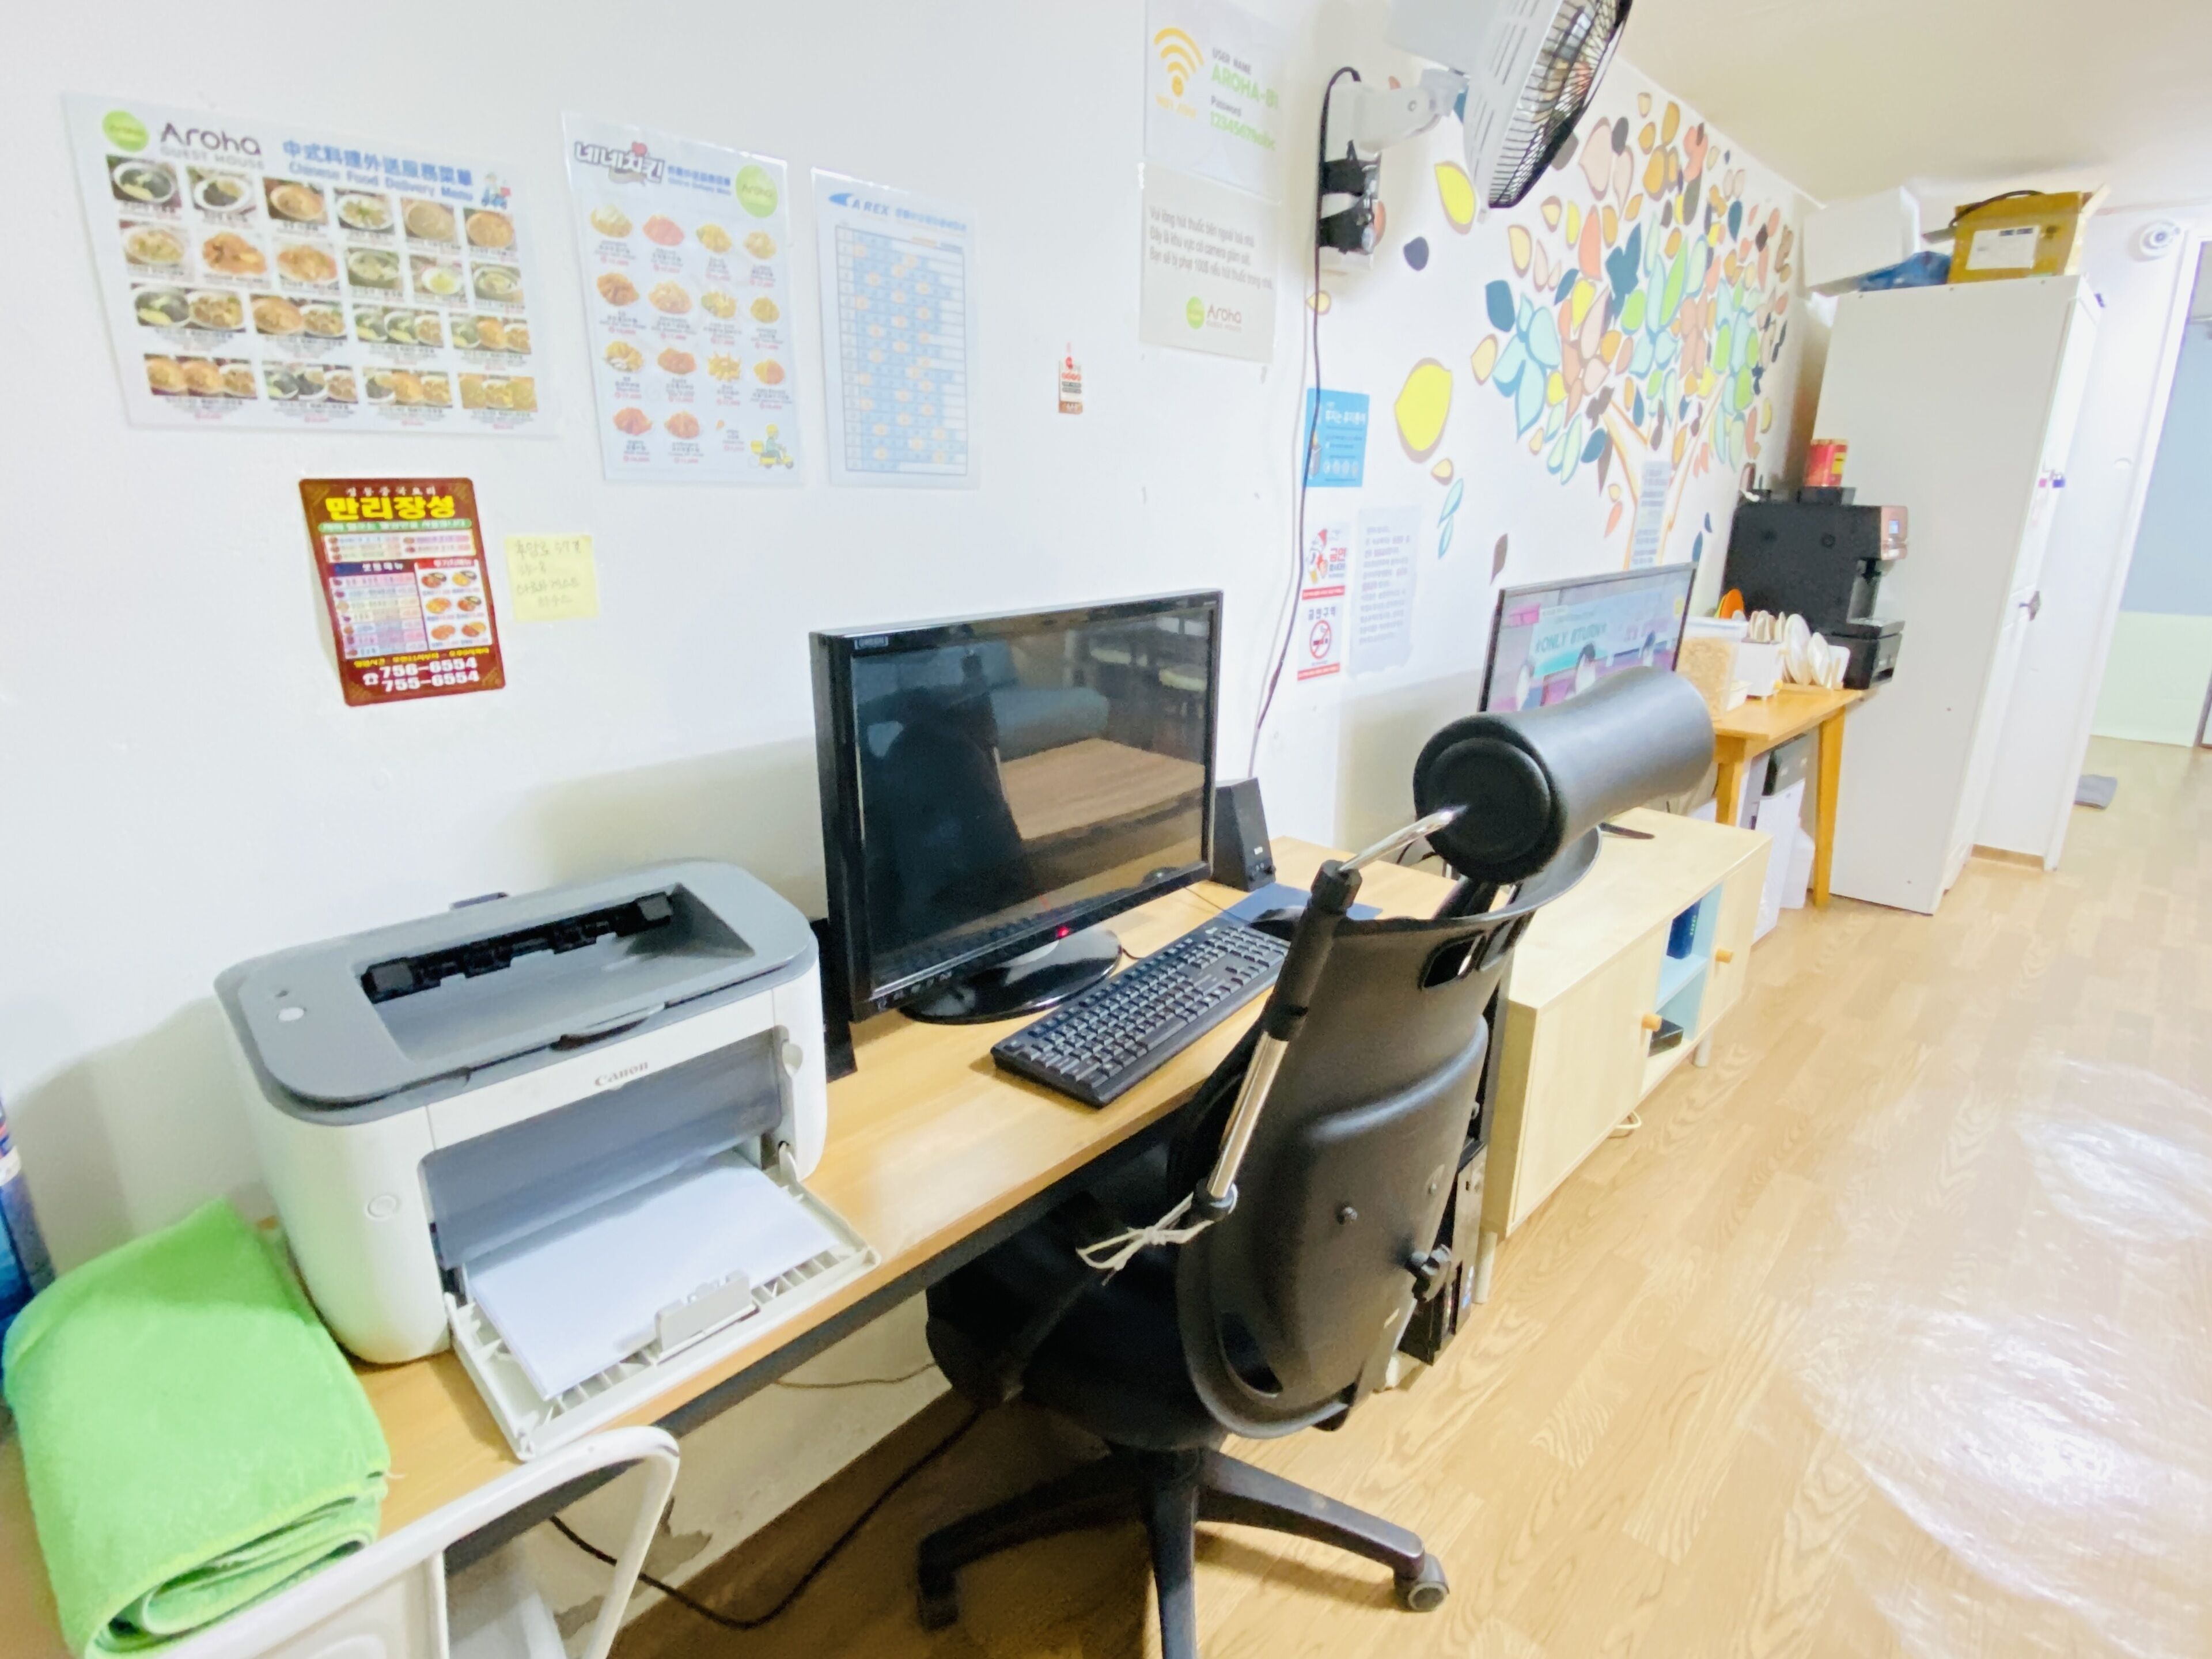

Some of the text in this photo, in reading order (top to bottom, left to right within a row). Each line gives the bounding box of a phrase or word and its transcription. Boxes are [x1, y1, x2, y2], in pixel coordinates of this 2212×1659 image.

[161, 122, 261, 155] Aroha
[574, 142, 665, 184] 네네치킨
[1207, 304, 1242, 324] Aroha
[325, 495, 456, 521] 만리장성
[1330, 548, 1346, 562] 금연
[1308, 607, 1336, 621] 금연구역
[381, 670, 480, 692] 755-6554
[594, 1062, 649, 1086] Canon
